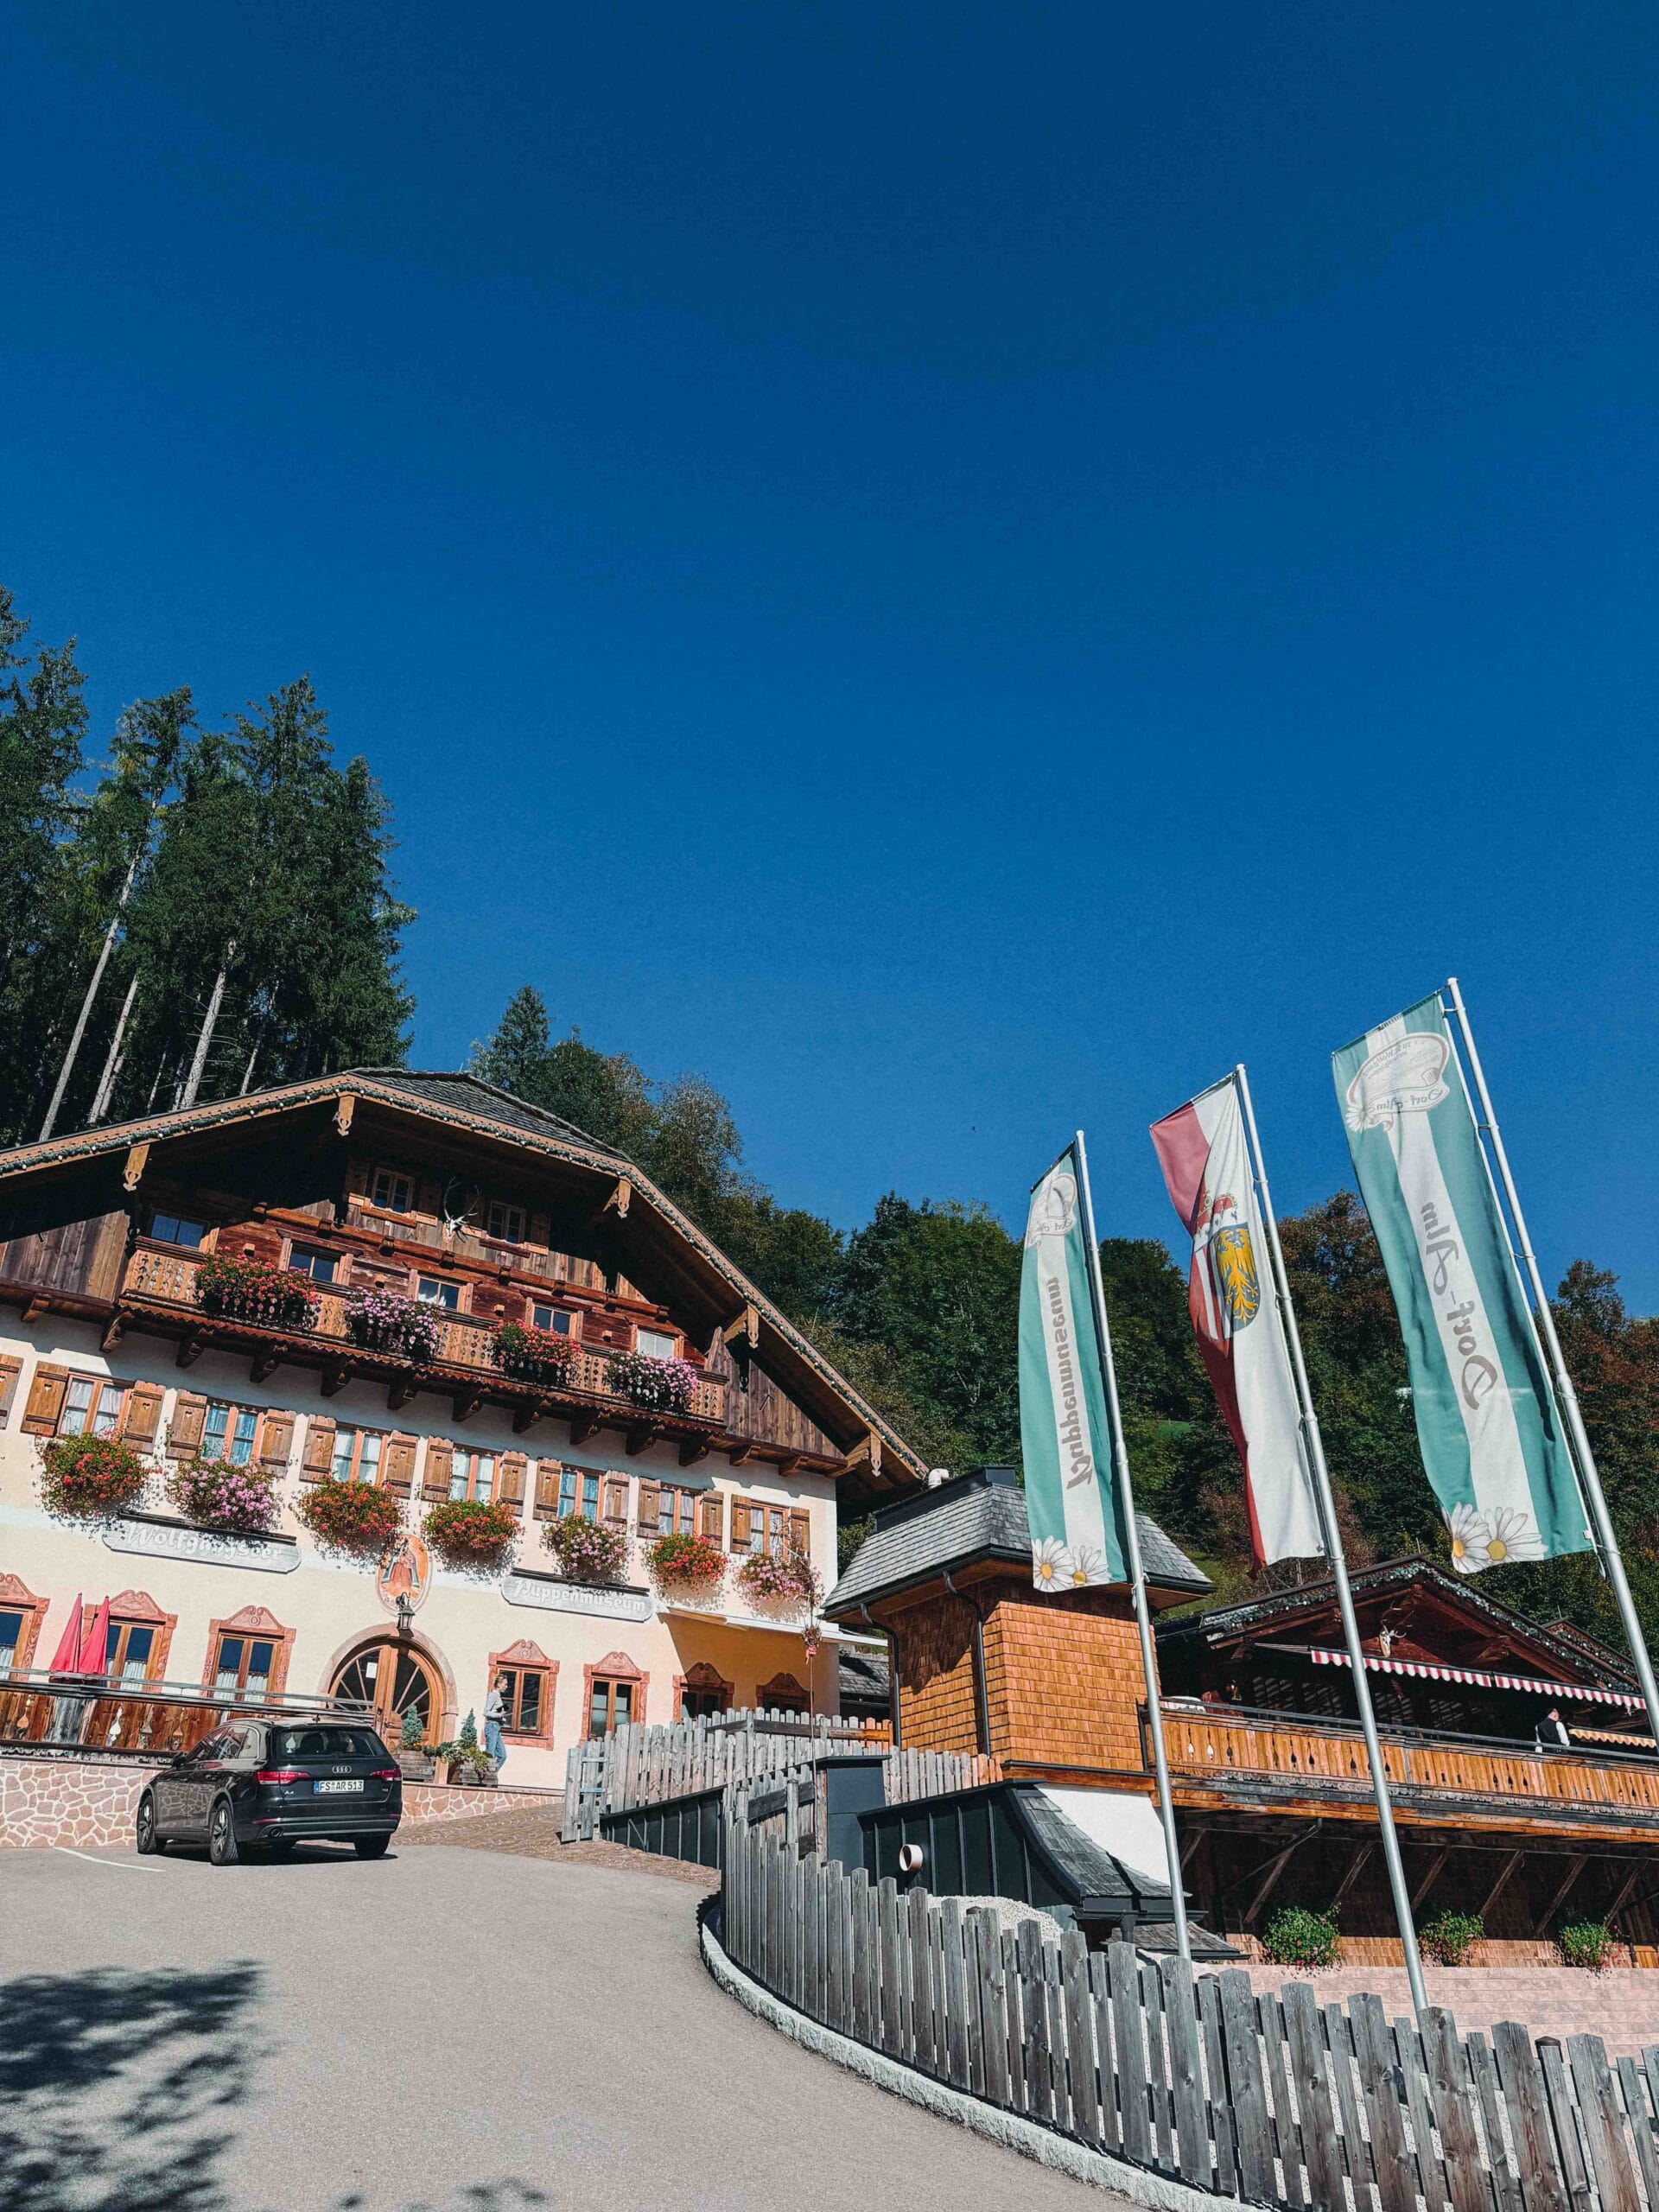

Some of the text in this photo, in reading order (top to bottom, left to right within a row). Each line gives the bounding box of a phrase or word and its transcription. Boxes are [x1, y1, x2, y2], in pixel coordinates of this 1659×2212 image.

[513, 1578, 646, 1611] Puppenmuseum
[321, 1782, 331, 1790] FS
[347, 1781, 363, 1789] 513
